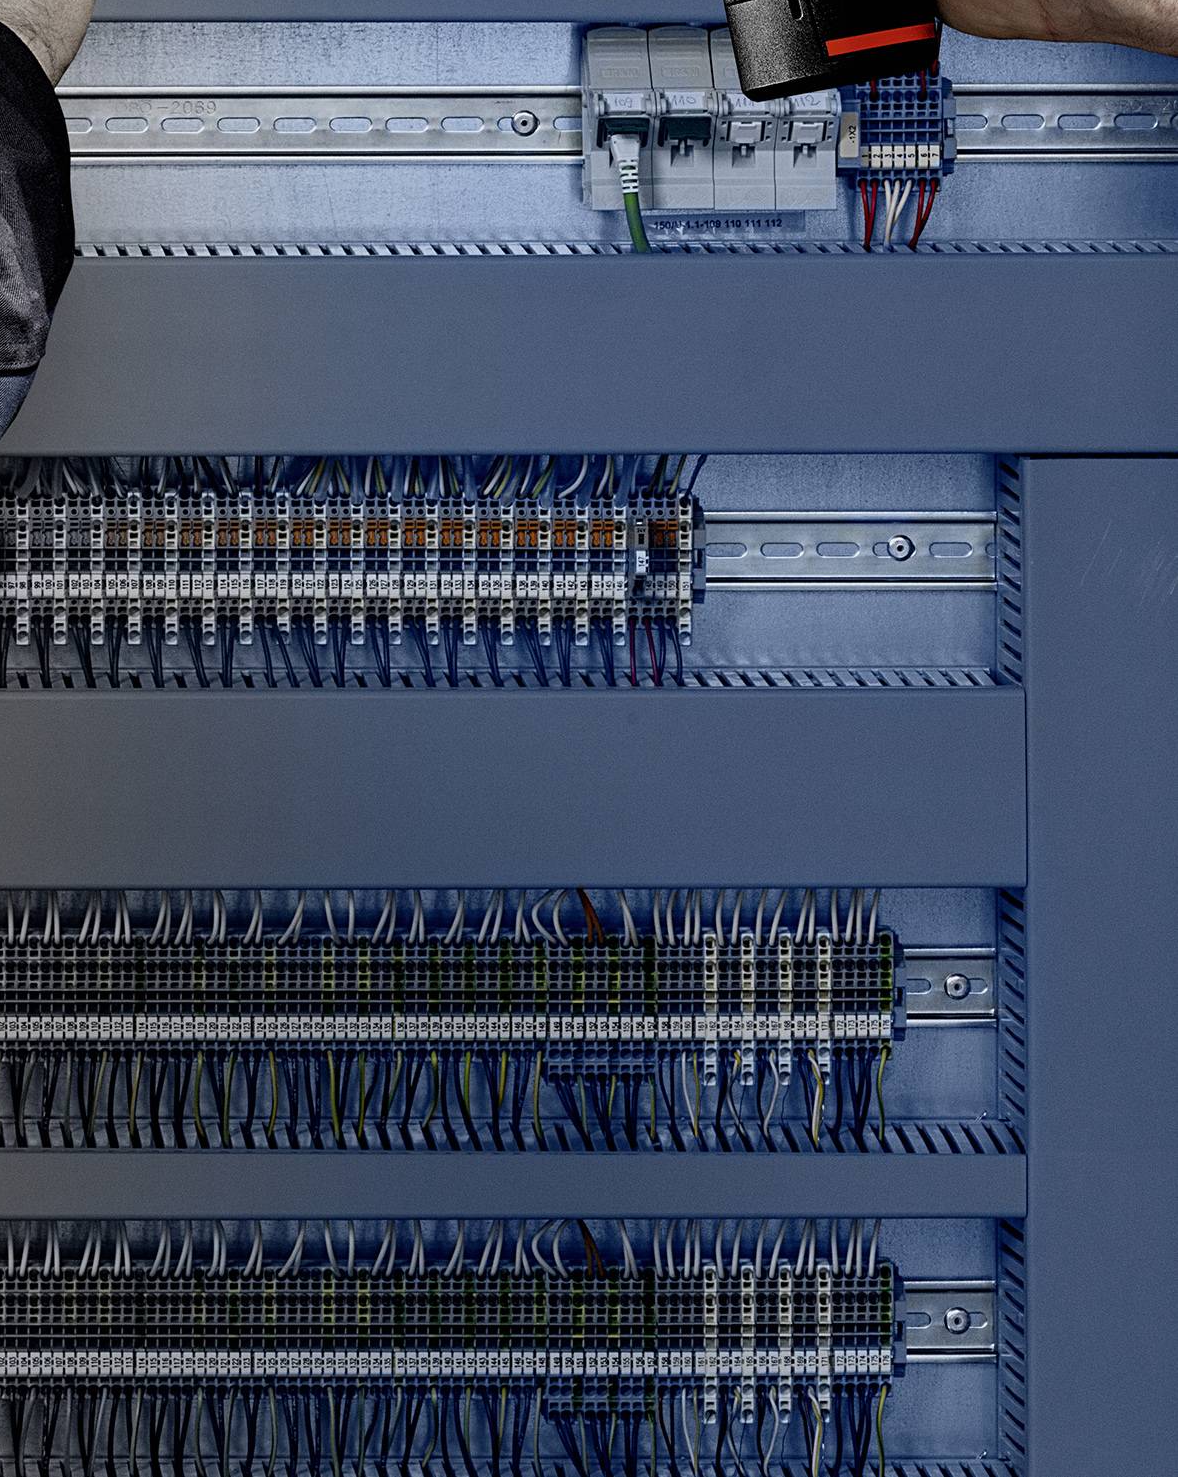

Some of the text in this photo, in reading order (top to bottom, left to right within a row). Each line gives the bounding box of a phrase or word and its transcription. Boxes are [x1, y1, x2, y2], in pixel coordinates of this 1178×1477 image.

[848, 124, 857, 144] -1X2
[724, 219, 742, 229] 110
[744, 218, 762, 228] 111
[764, 218, 783, 228] 112
